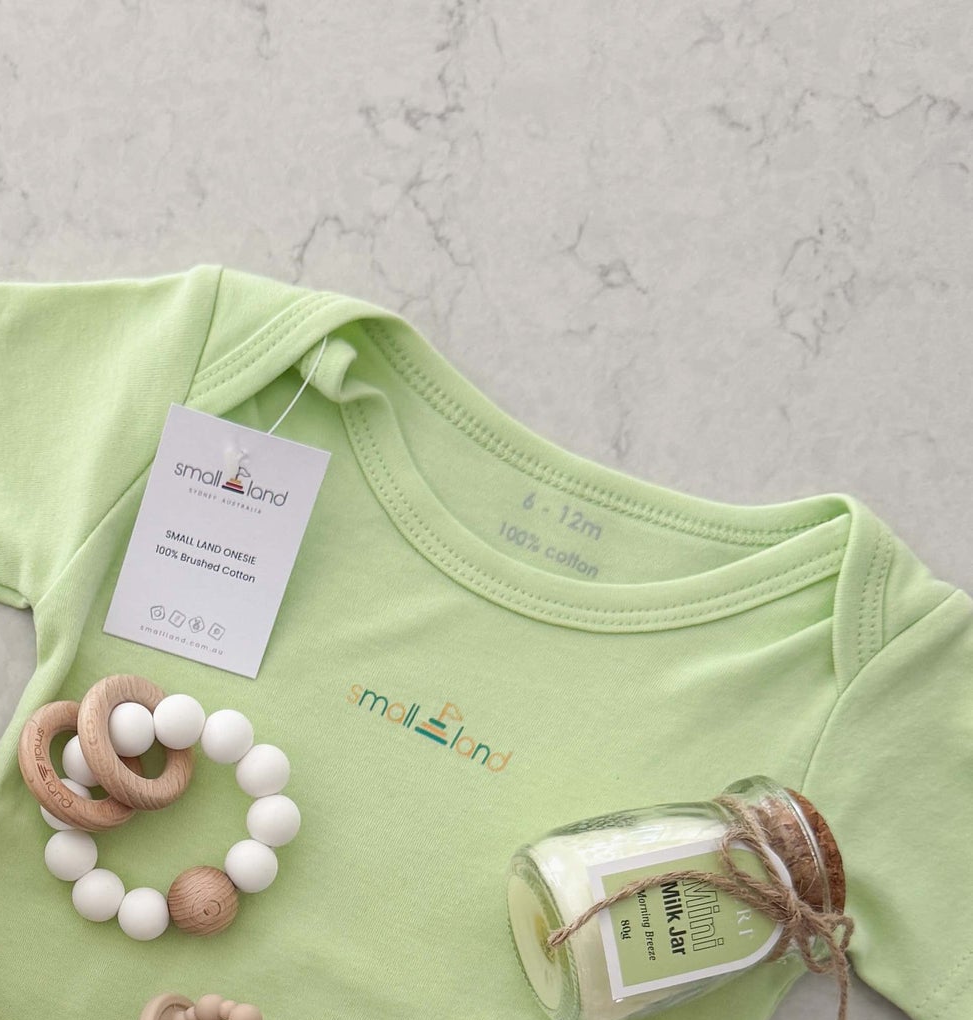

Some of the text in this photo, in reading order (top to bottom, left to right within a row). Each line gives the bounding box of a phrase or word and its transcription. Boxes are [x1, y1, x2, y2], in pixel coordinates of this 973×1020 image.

[174, 462, 289, 507] small land
[188, 487, 262, 514] SYDNEY AUSTRALIA
[499, 521, 540, 552] 100%
[558, 505, 602, 541] 12m
[155, 544, 256, 583] 100% Brushed Cotton
[165, 529, 257, 565] SMALL LAND ONESIE
[140, 623, 224, 656] smallland.com.au
[346, 684, 514, 773] small land
[34, 727, 74, 809] small land
[620, 919, 631, 940] 80g
[637, 889, 656, 961] Morning Breeze
[660, 880, 687, 955] Milk Jar
[682, 877, 724, 952] Mini
